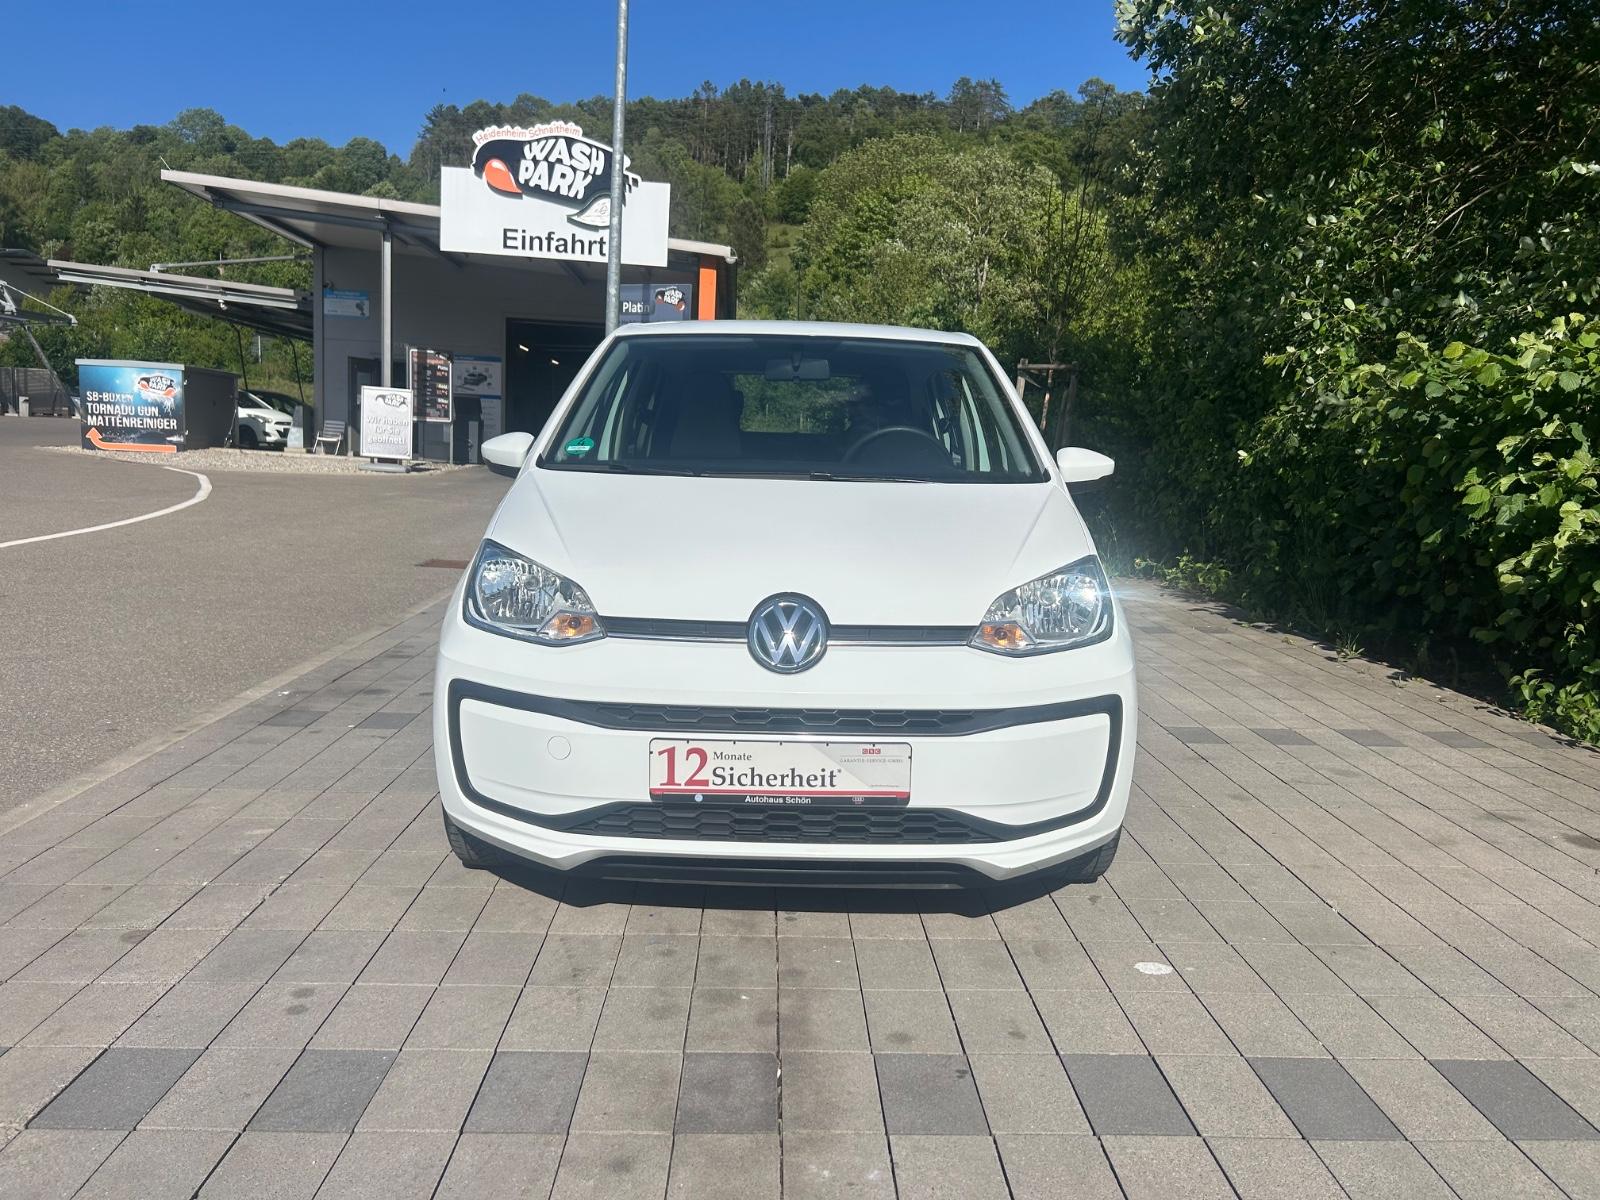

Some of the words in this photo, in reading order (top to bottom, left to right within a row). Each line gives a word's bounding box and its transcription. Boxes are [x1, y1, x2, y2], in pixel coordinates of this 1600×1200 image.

[477, 128, 526, 144] Heidenheim
[528, 125, 581, 138] Schnaitheim
[523, 137, 605, 176] WASH
[518, 158, 593, 200] PARK
[502, 227, 607, 257] Einfahrt
[622, 301, 650, 313] Platin
[86, 402, 135, 416] TORNADO
[87, 415, 178, 430] MATTENREINIGER
[657, 746, 710, 788] 12
[713, 750, 752, 762] Monate
[744, 795, 784, 804] Autohaus
[785, 795, 811, 805] Schön
